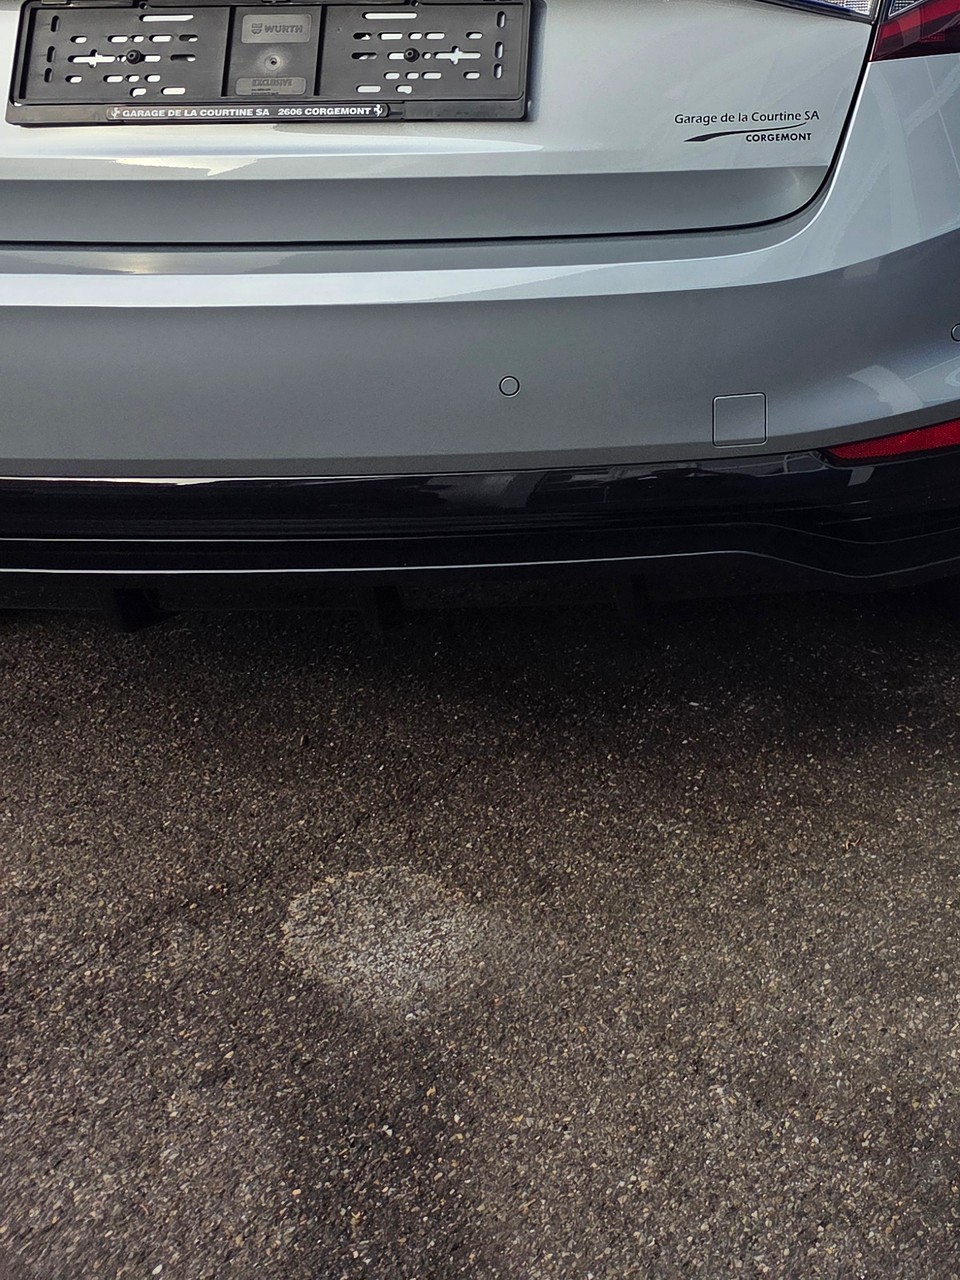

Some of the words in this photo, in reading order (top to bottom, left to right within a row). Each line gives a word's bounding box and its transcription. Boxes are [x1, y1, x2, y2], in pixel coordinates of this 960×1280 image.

[123, 109, 165, 117] GARAGE
[167, 108, 182, 117] DE
[184, 108, 197, 117] LA
[199, 108, 253, 117] COURTINE
[255, 108, 270, 116] SA
[277, 107, 303, 116] 2606
[304, 107, 371, 116] CORGEMONT
[674, 113, 718, 126] Garage
[720, 112, 735, 123] de
[738, 112, 748, 122] la
[751, 110, 802, 122] Courtine
[804, 110, 820, 121] SA
[745, 132, 812, 143] CORGEMONT
